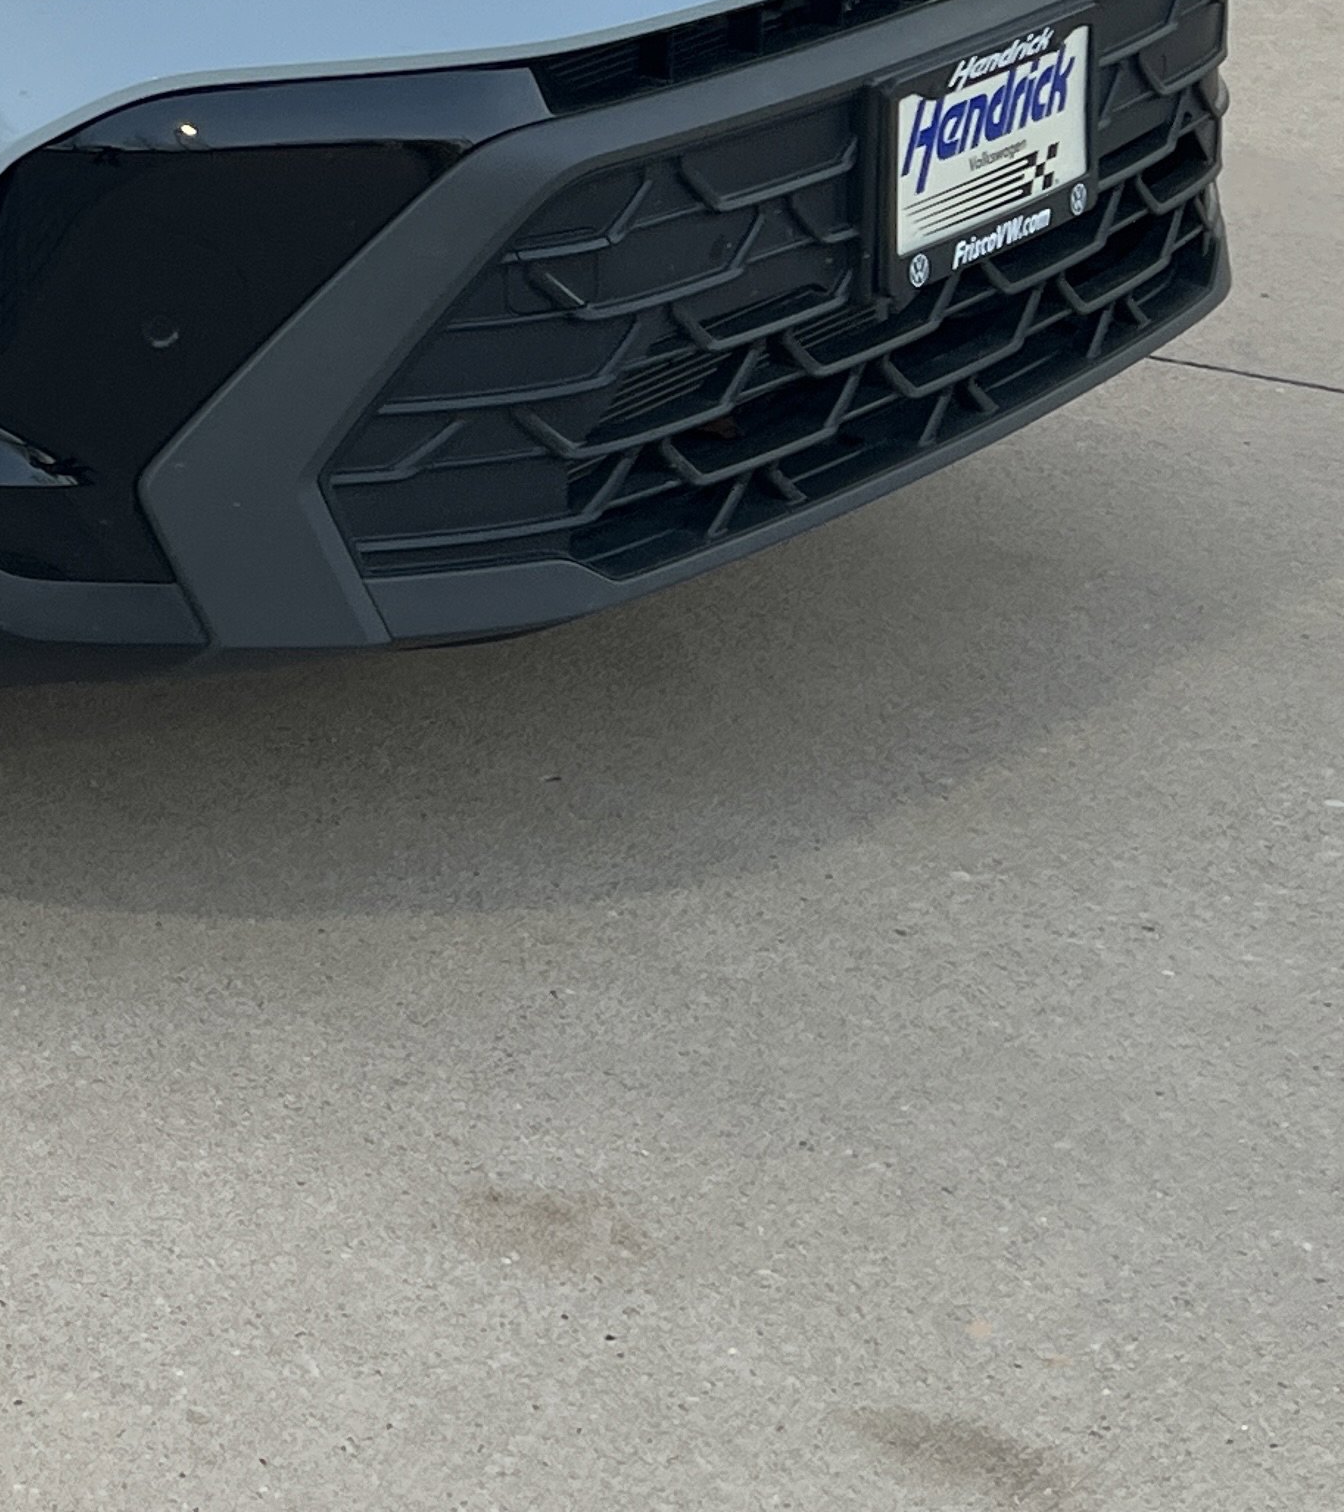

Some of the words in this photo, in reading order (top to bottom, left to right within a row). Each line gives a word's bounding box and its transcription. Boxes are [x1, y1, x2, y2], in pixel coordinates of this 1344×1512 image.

[947, 27, 1054, 88] Hendrick
[900, 41, 1076, 195] Hendrick
[952, 208, 1051, 270] FriscoVW.com
